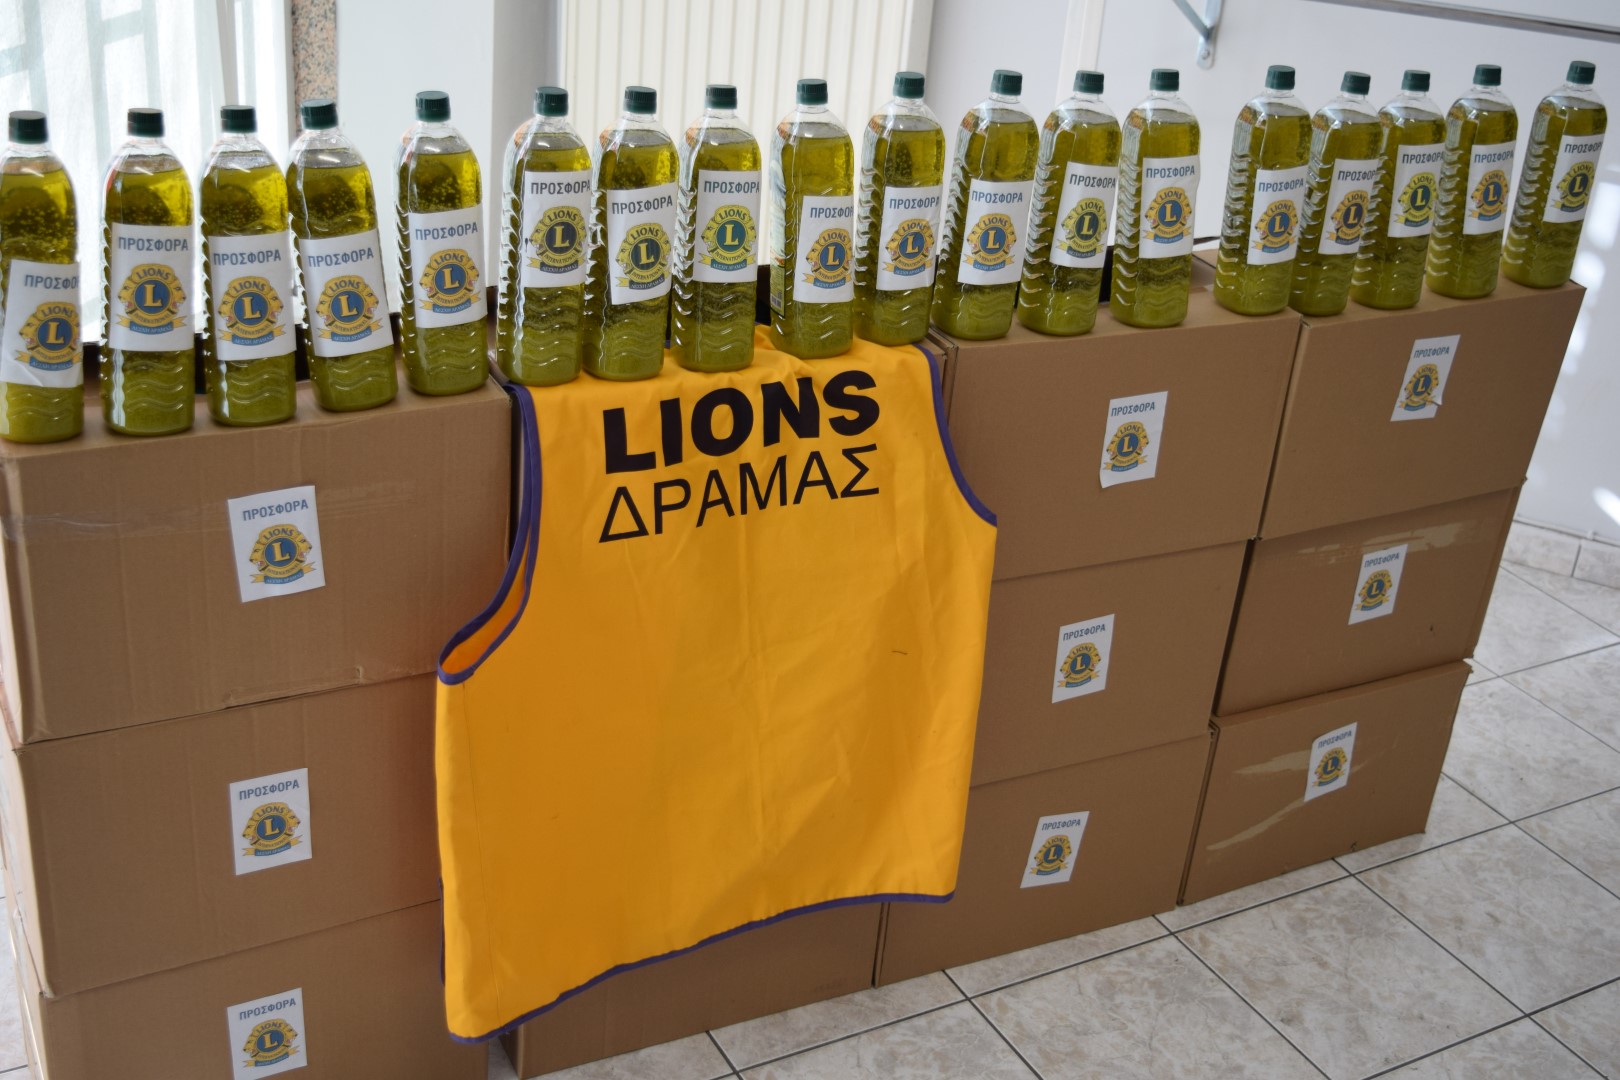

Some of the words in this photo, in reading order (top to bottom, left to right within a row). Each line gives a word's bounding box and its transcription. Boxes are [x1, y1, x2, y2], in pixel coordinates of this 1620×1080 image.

[1146, 165, 1195, 178] ΠΡΟΣΦΟΡΑ
[1338, 170, 1377, 181] ΠΡΟΣΦΟΡ
[1070, 174, 1116, 188] ΠΡΟΣΦΟΡΑ
[1258, 178, 1304, 192] ΠΡΟΣΦΟΡΑ
[1573, 176, 1584, 192] L
[972, 190, 1023, 204] ΠΡΟΣΦΟΡΑ
[1160, 190, 1182, 200] LIONS
[1414, 188, 1426, 206] L
[1488, 184, 1498, 201] L
[611, 195, 673, 214] ΠΡΟΣΦΟΡΑ
[1080, 201, 1102, 210] LIONS
[1270, 202, 1291, 212] LIONS
[547, 209, 578, 222] LIONS
[718, 209, 748, 220] LIONS
[1164, 204, 1177, 222] L
[1348, 206, 1358, 224] L
[902, 222, 927, 232] LIONS
[982, 216, 1007, 227] LIONS
[1080, 215, 1093, 235] L
[1274, 216, 1285, 232] L
[415, 221, 478, 240] ΠΡΟΣΦΟΡΑ
[553, 226, 570, 248] L
[630, 226, 660, 240] LIONS
[724, 224, 739, 246] L
[822, 232, 848, 242] LIONS
[118, 237, 189, 251] ΠΡΟΣΦΟΡΑ
[906, 236, 918, 254] L
[986, 230, 1000, 249] L
[213, 249, 281, 266] ΠΡΟΣΦΟΡΑ
[308, 247, 374, 267] ΠΡΟΣΦΟΡΑ
[434, 252, 465, 265] LIONS
[638, 242, 655, 265] L
[826, 246, 840, 266] L
[24, 274, 79, 290] ΠΡΟΣΦΟ
[136, 268, 171, 280] LIONS
[442, 268, 459, 289] L
[233, 280, 266, 293] LIONS
[330, 279, 360, 292] LIONS
[143, 284, 163, 307] L
[242, 296, 261, 319] L
[339, 295, 358, 317] L
[46, 321, 65, 344] L
[1413, 346, 1450, 359] ΠΡΟΣΦΟΡΑ
[1416, 377, 1426, 392] L
[1110, 402, 1156, 417] ΠΡΟΣΦΟΡΑ
[602, 370, 880, 474] LIONS
[1120, 424, 1141, 434] LIONS
[1122, 436, 1134, 453] L
[598, 443, 880, 543] ΔΡΑΜΑΣ
[242, 499, 309, 521] ΠΡΟΣΦΟΡΑ
[263, 528, 294, 541] LIONS
[272, 541, 290, 562] L
[1364, 552, 1400, 568] ΠΡΟΣΦΟΡΑ
[1371, 581, 1380, 594] L
[1062, 624, 1106, 642] ΠΡΟΣΦΟΡΑ
[1075, 656, 1086, 671] L
[1327, 760, 1336, 772] L
[239, 779, 300, 800] ΠΡΟΣΦΟΡΑ
[256, 806, 284, 818] LIONS
[264, 818, 280, 836] L
[1041, 818, 1080, 831] ΠΡΟΣΦΟΡΑ
[1048, 846, 1057, 860] L
[239, 998, 296, 1020] ΠΡΟΣΦΟΡΑ
[262, 1032, 278, 1049] L
